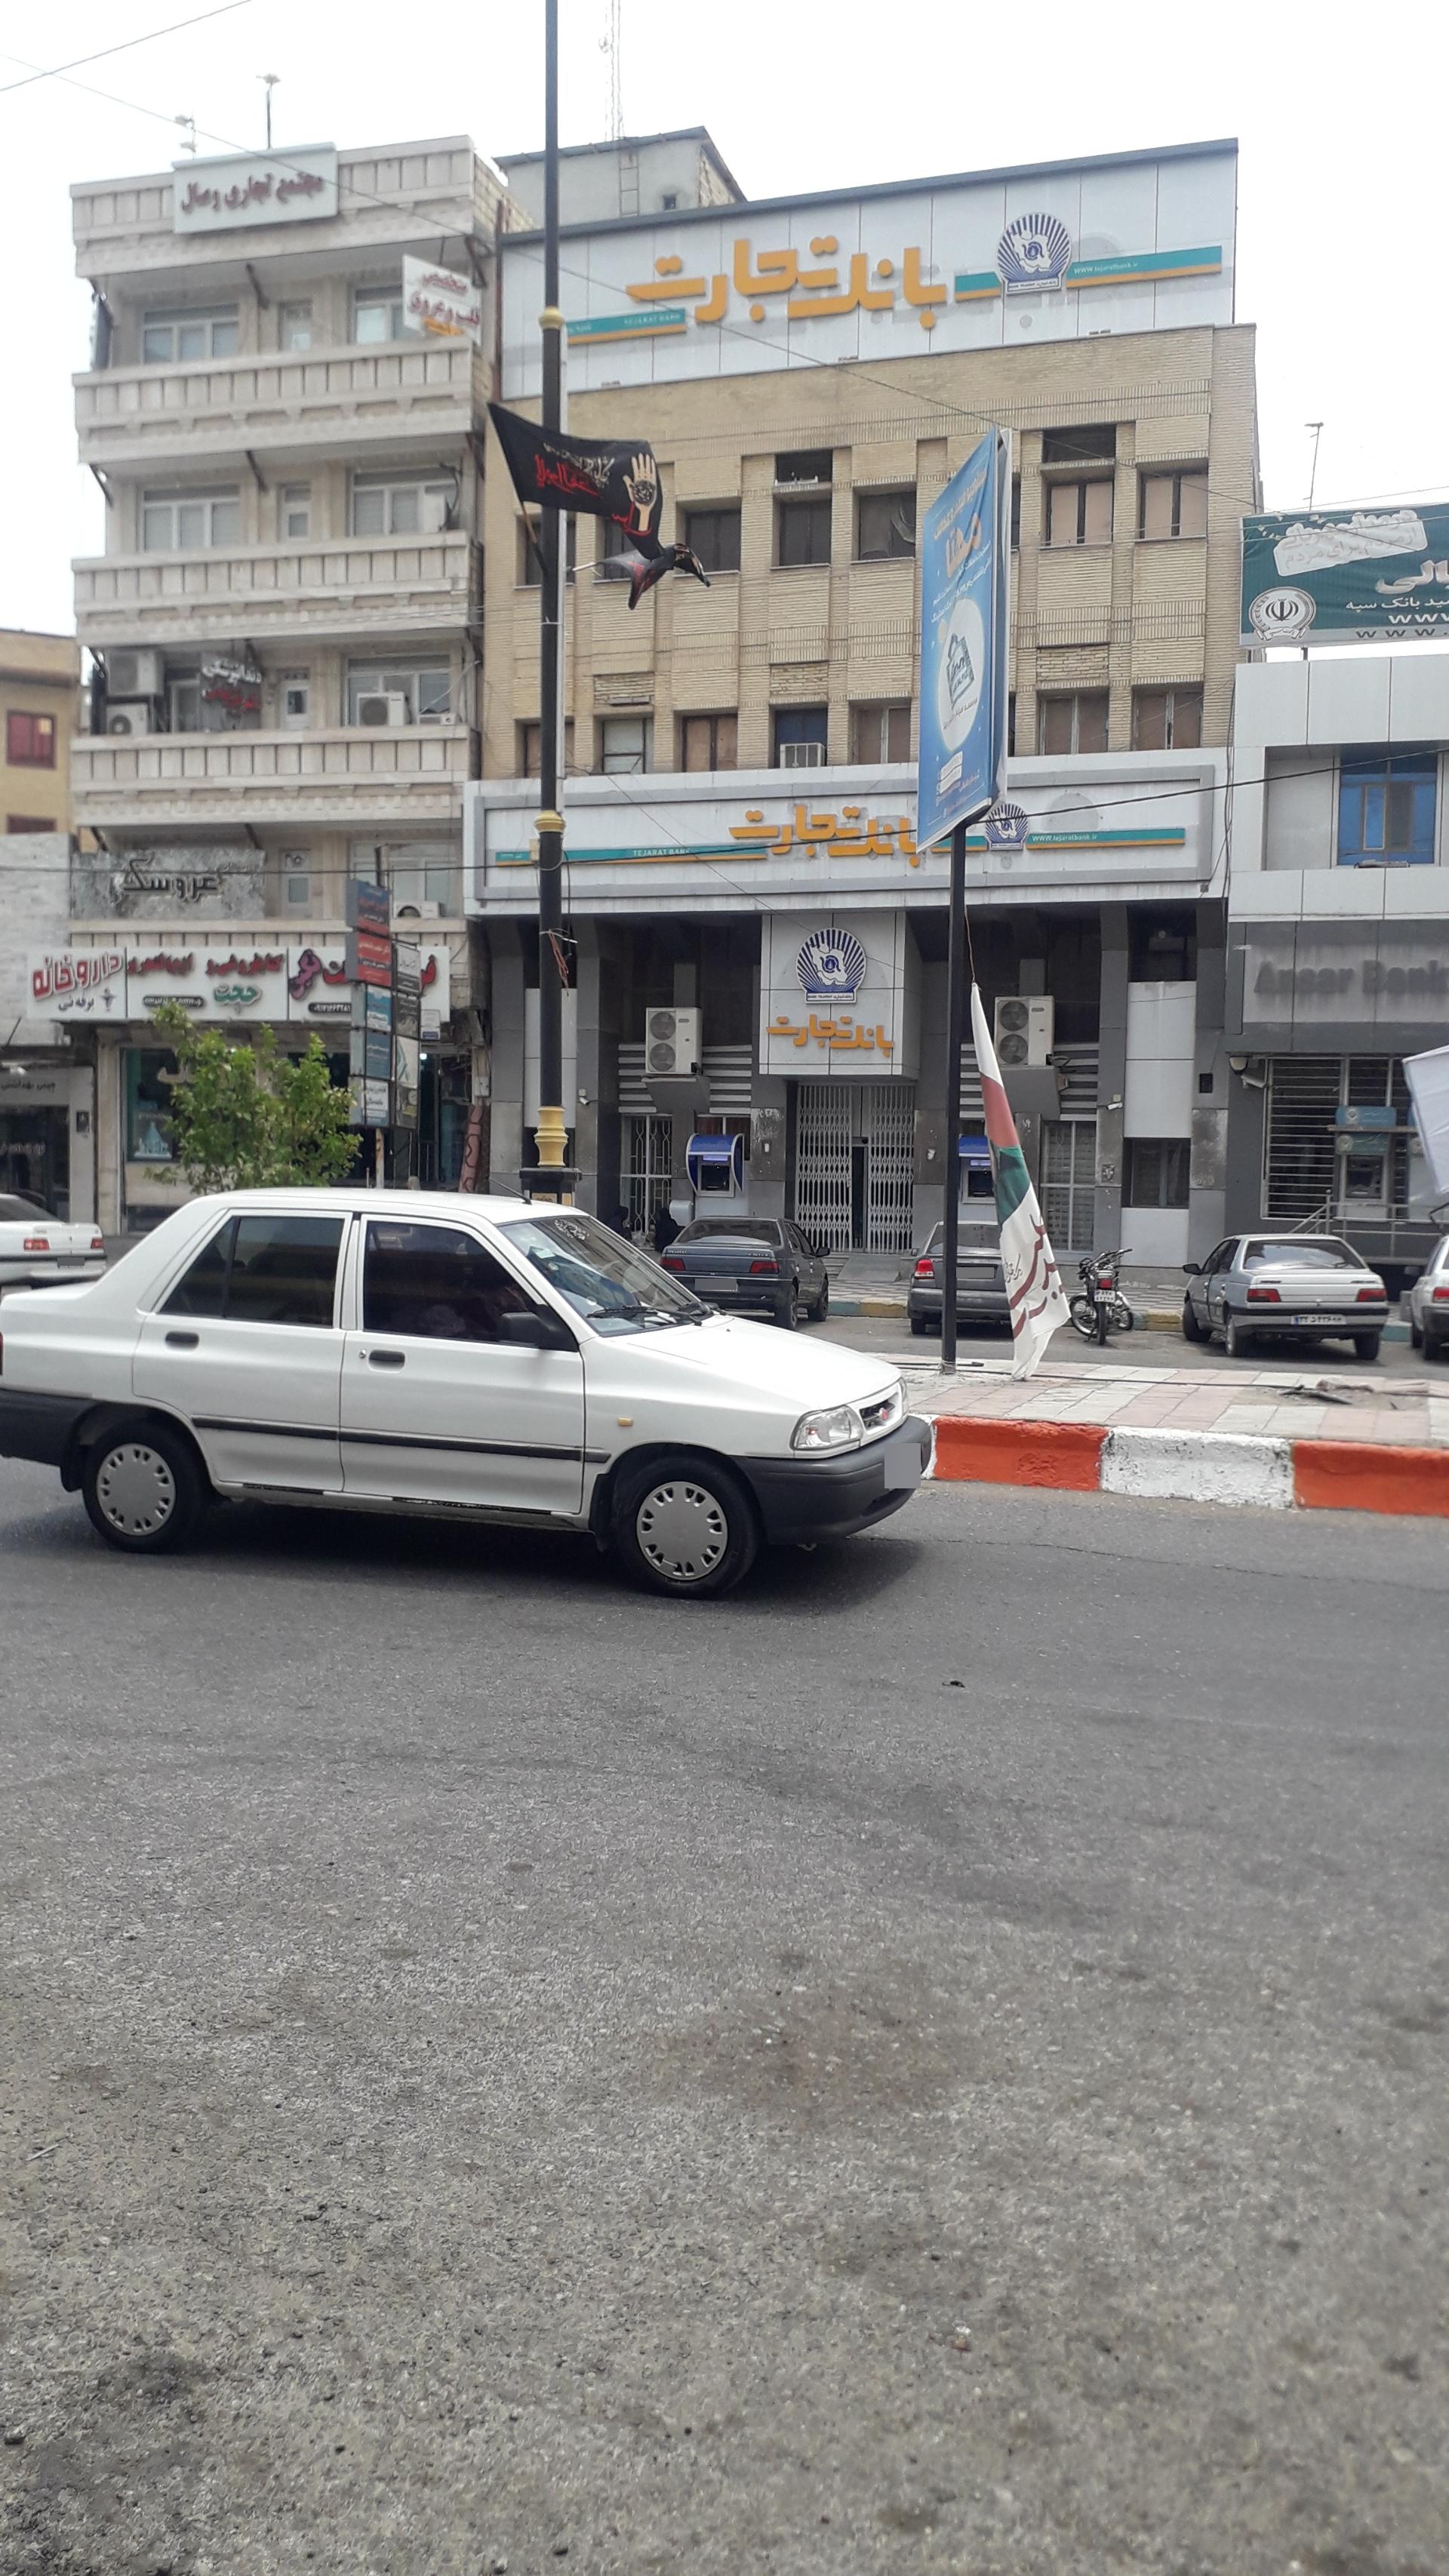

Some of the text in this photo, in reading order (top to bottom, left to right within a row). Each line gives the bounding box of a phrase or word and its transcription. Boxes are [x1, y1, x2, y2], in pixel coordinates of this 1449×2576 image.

[180, 171, 324, 214] مجتمع تجاری وصال
[625, 235, 947, 331] بانک تجارت
[1284, 551, 1324, 571] مردم
[1346, 602, 1377, 613] سپه
[1381, 596, 1420, 609] بانک
[633, 849, 670, 857] TEJARAT
[729, 804, 917, 868] بانک تجارت
[123, 854, 219, 900] عروسک
[32, 953, 124, 1002] داروخانه
[214, 983, 262, 1006] حجت
[765, 1013, 894, 1057] بانک تجارت
